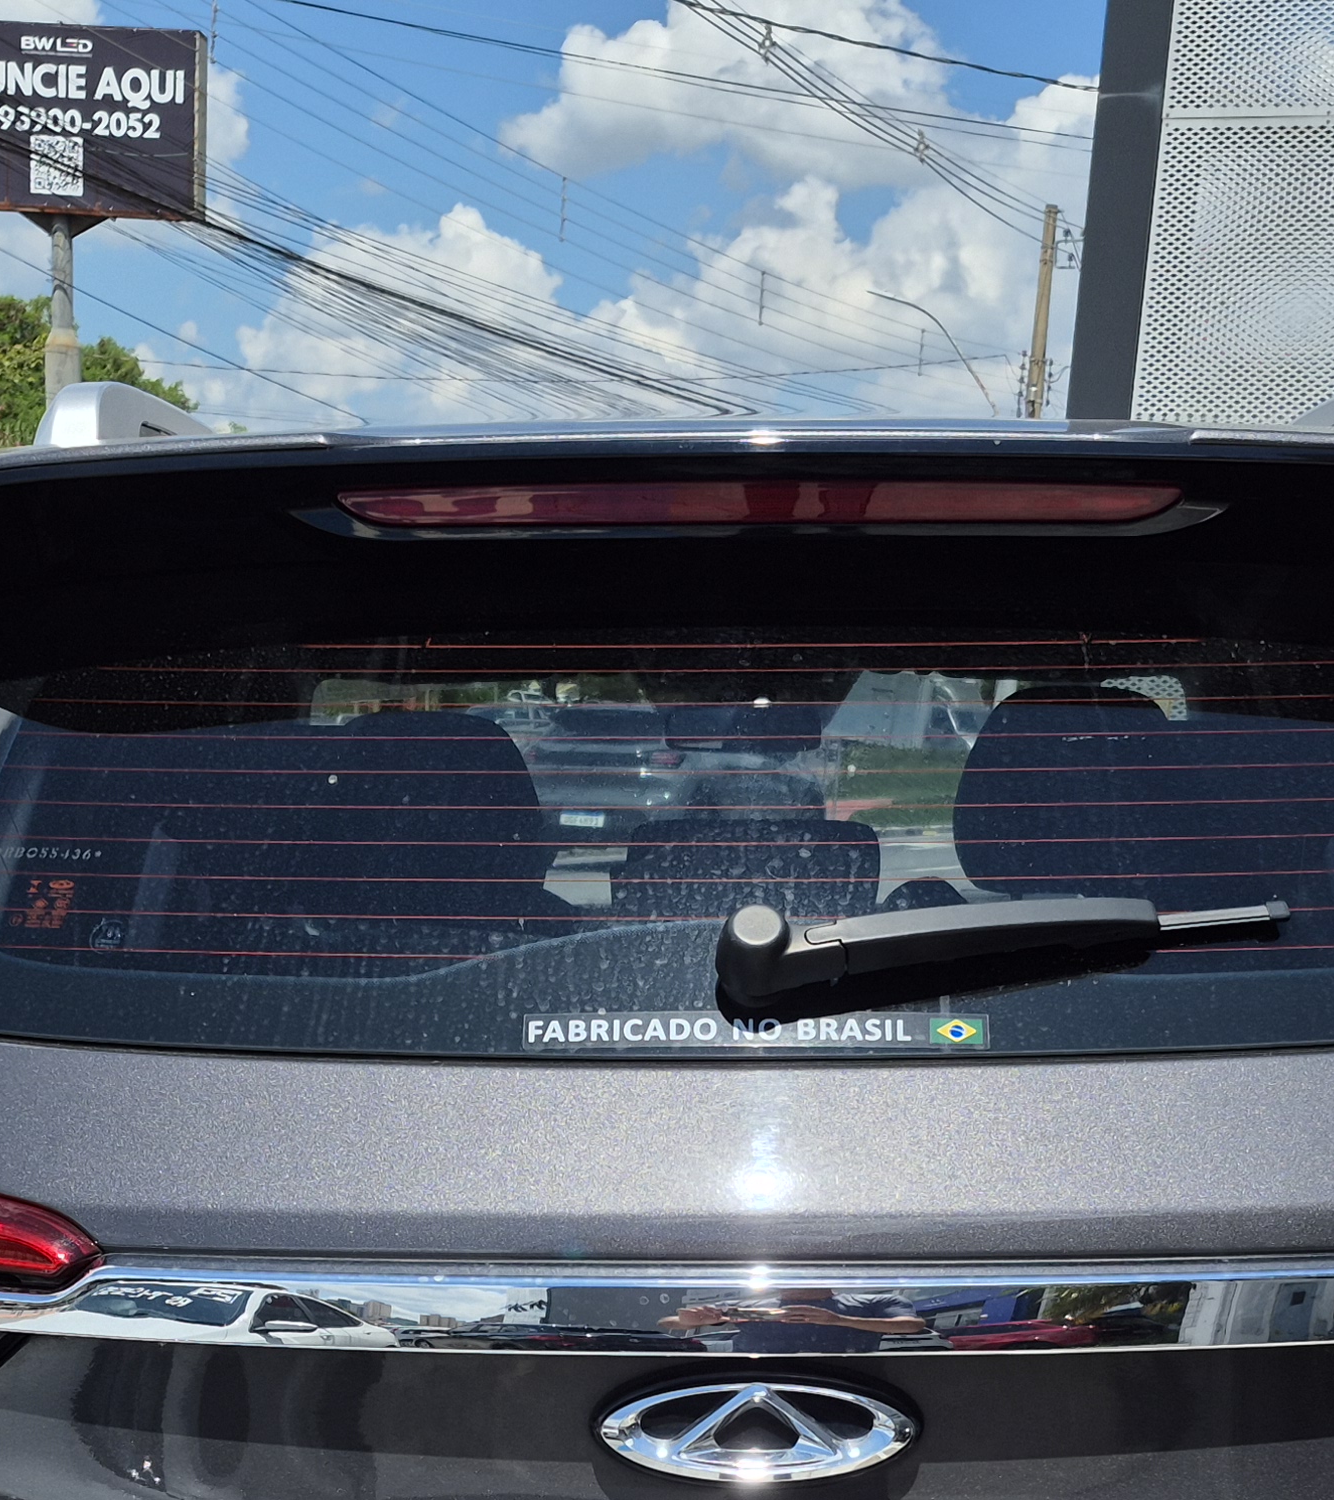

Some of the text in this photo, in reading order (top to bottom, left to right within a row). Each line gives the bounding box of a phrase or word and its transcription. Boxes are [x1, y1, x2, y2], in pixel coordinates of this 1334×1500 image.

[93, 66, 185, 110] AQUI
[528, 1018, 912, 1043] FABRICADO NO BRASIL
